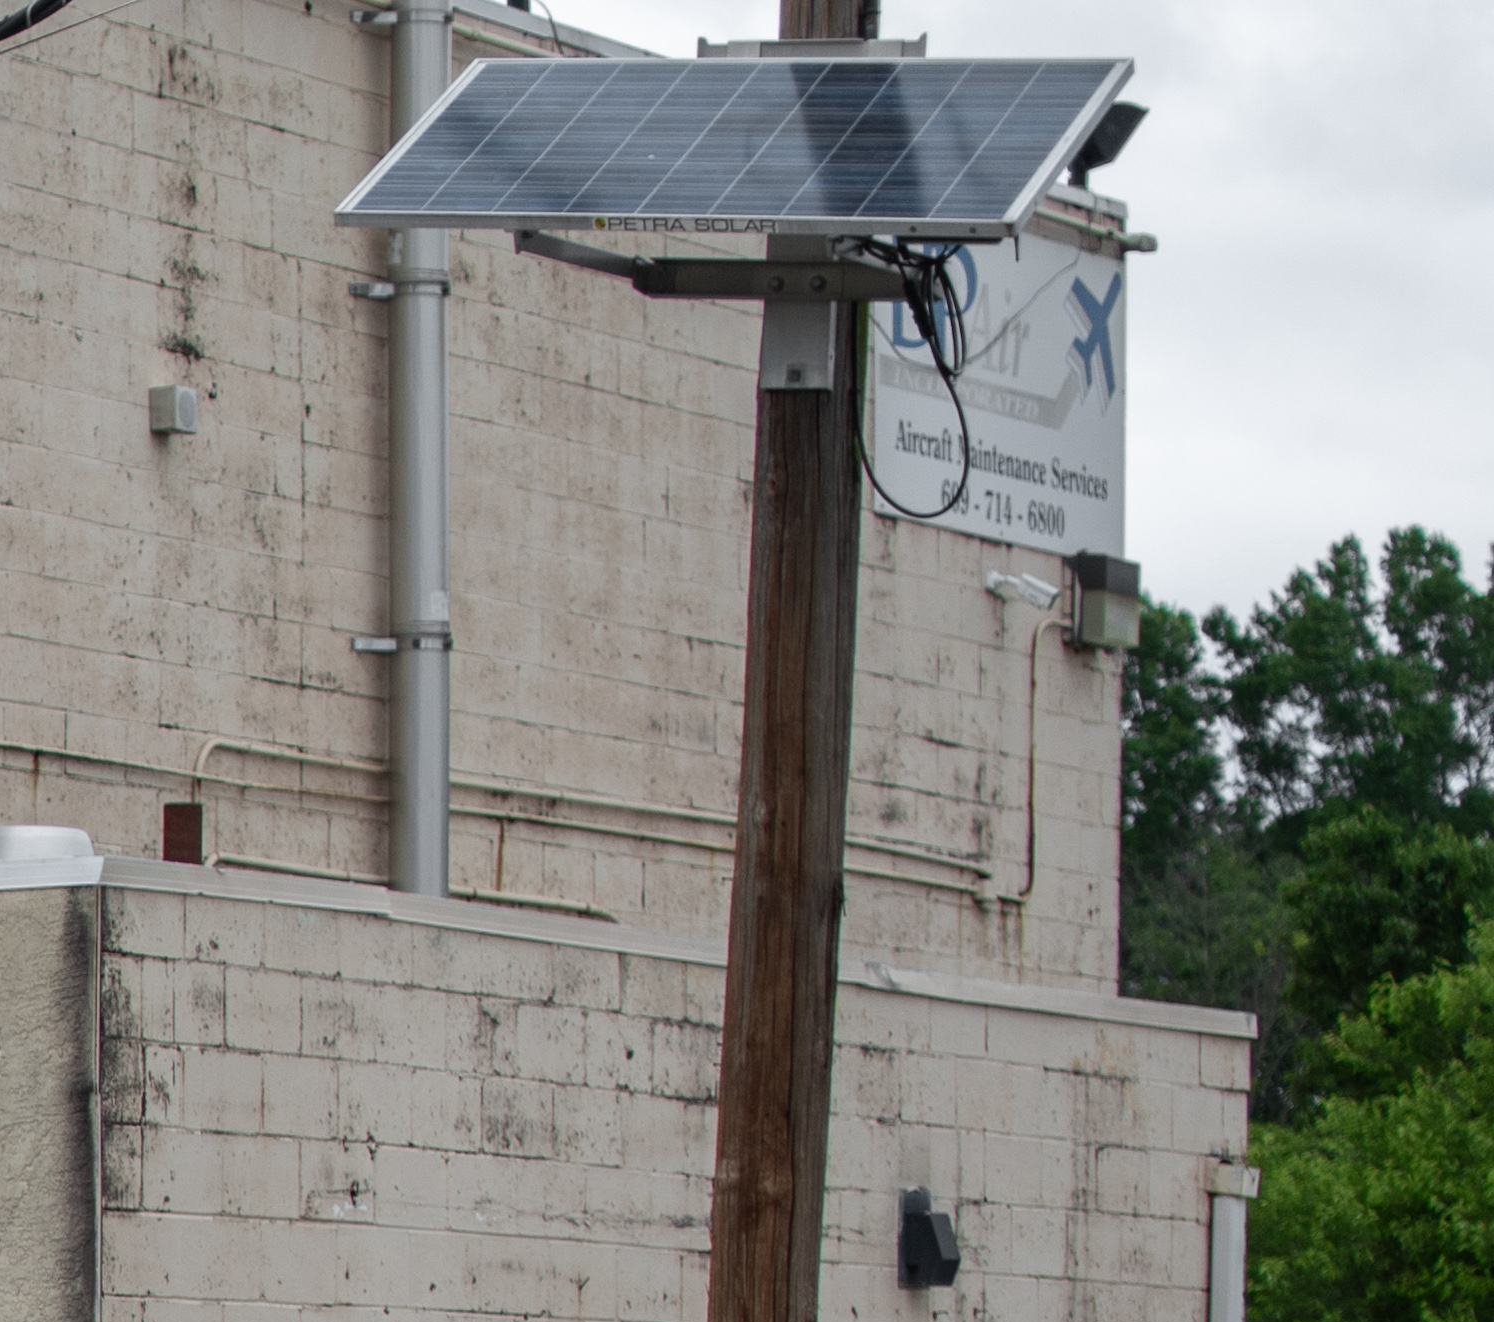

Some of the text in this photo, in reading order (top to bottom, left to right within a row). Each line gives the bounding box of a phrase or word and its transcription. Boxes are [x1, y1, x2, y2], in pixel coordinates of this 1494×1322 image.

[608, 217, 776, 233] PETRA SOLAR
[895, 419, 953, 463] Aircraft
[1051, 456, 1109, 501] Services
[985, 489, 1012, 526] 714
[1027, 499, 1065, 539] 6800
